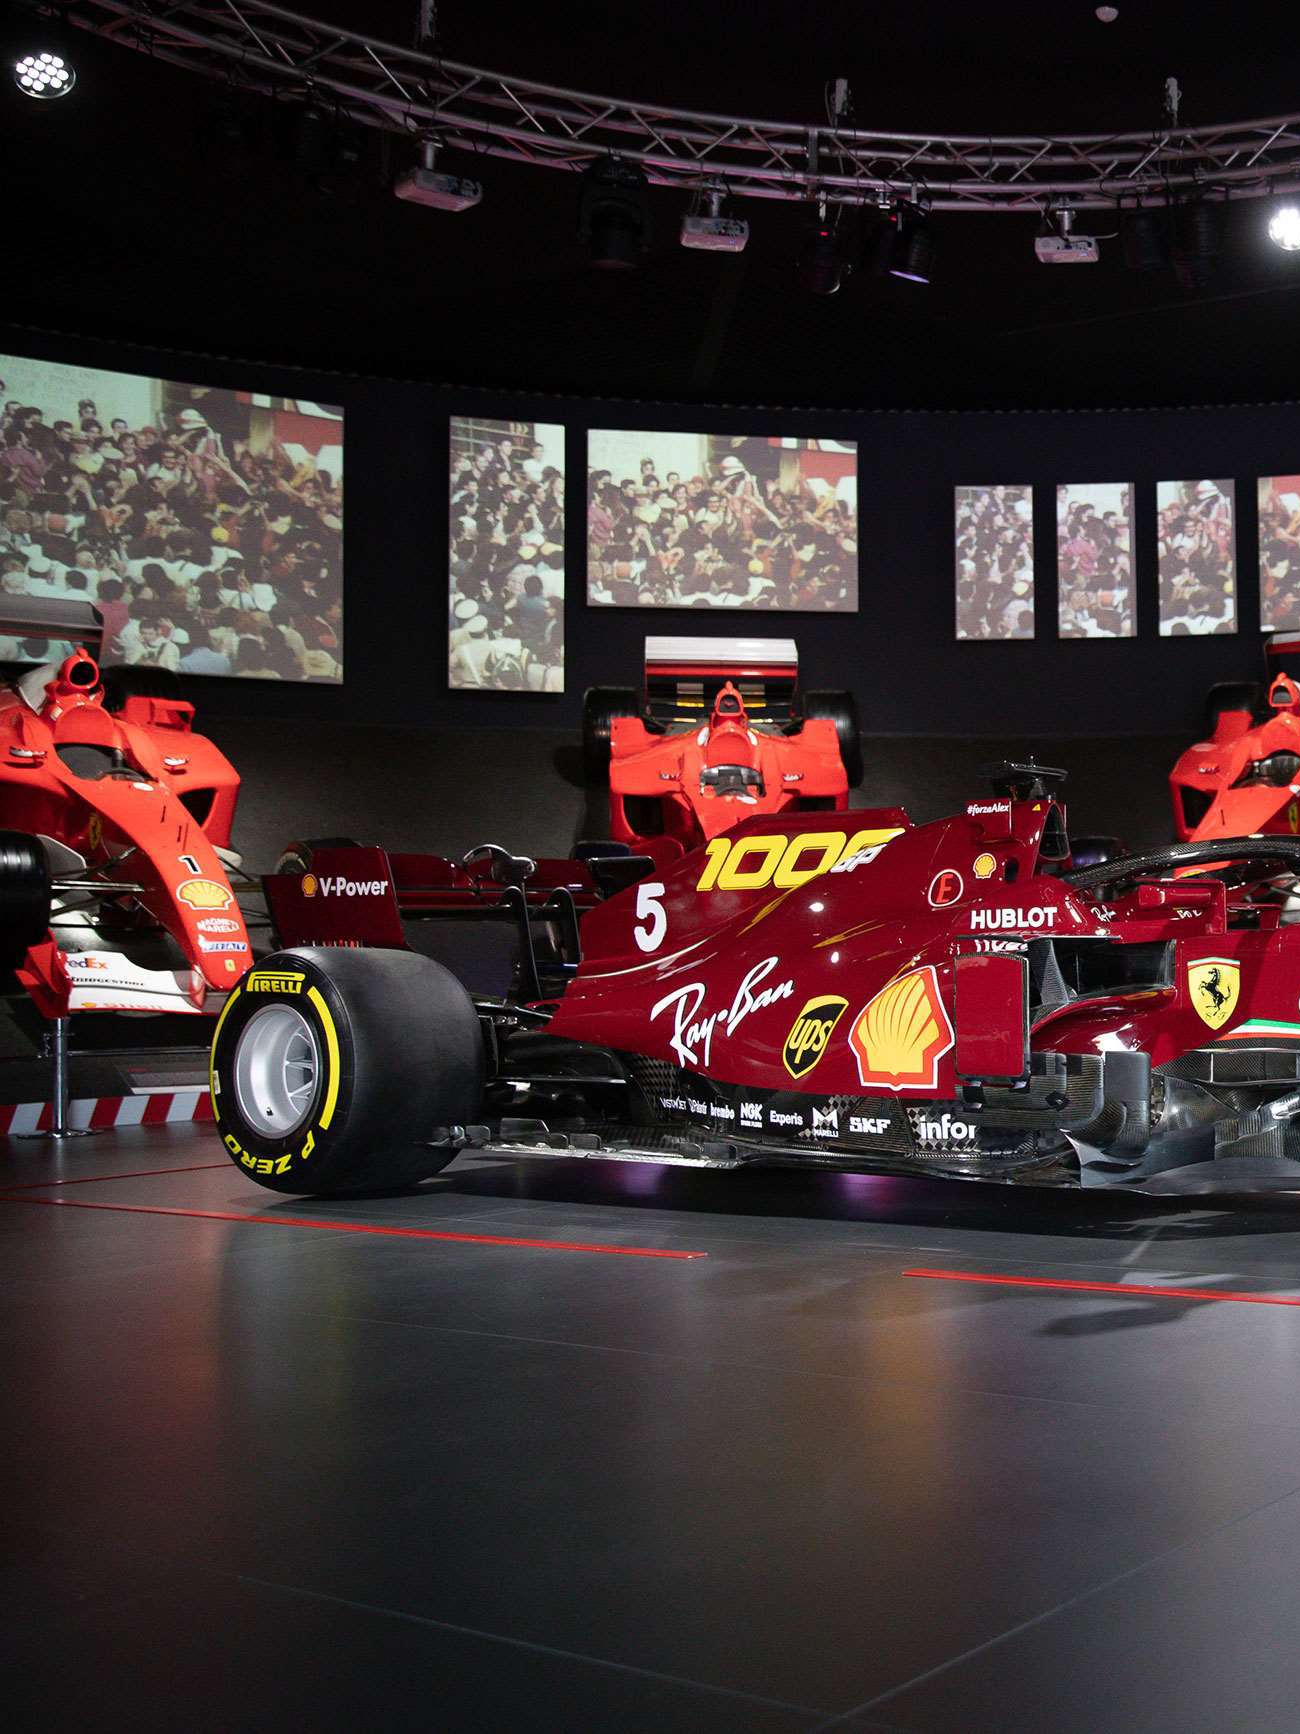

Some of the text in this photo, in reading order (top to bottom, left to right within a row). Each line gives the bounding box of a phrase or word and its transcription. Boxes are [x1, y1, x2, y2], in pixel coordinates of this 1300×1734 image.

[967, 803, 1009, 816] #forzaAlex
[177, 856, 203, 874] 1
[319, 876, 389, 898] V-Power
[934, 877, 953, 904] E
[633, 882, 668, 953] 5
[970, 907, 1057, 929] HUBLOT
[68, 957, 108, 969] edEx
[246, 971, 306, 994] PIRELLI
[788, 1019, 833, 1064] ups
[710, 1102, 735, 1120] brembo
[740, 1103, 763, 1121] NGK
[770, 1110, 803, 1126] Experis
[814, 1129, 839, 1138] MARELLI
[850, 1117, 891, 1135] SKF
[919, 1114, 977, 1140] infor
[225, 1129, 316, 1176] P ZERO
